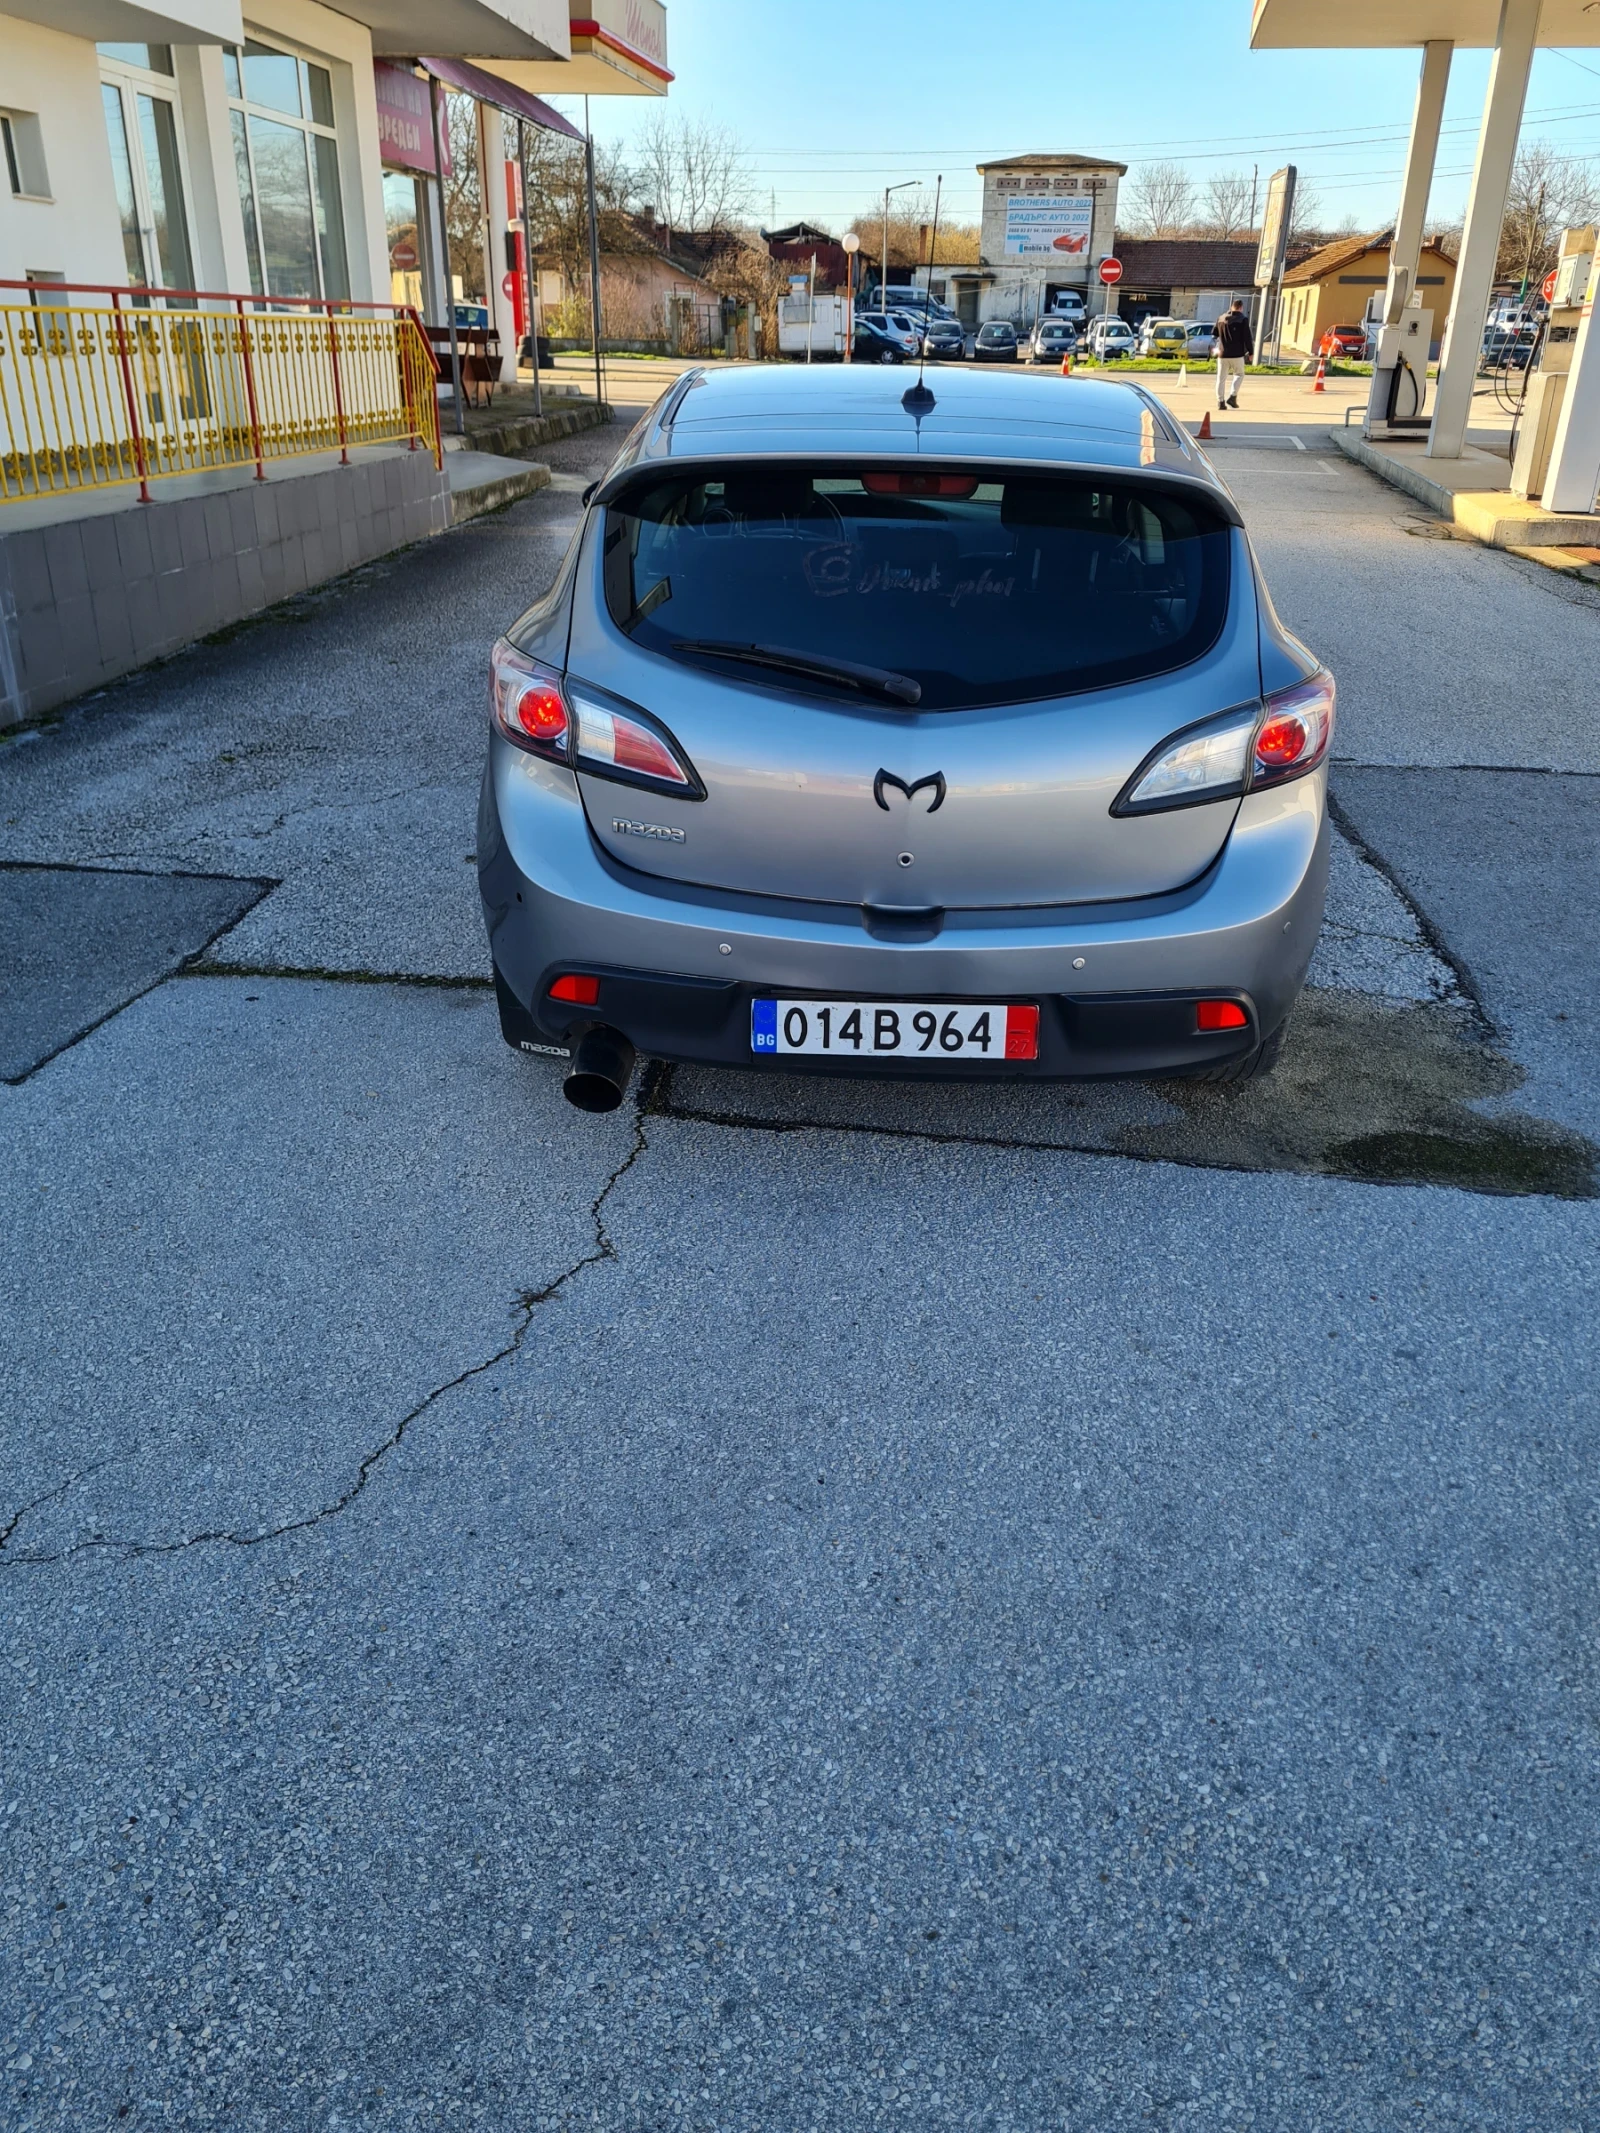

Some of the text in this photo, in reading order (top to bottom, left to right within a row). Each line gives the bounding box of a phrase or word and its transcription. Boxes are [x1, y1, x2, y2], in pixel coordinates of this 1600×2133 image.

[1008, 199, 1050, 207] BROTHERS
[1052, 199, 1073, 207] AUTO
[1008, 213, 1047, 222] БРАДЪРС
[757, 1034, 775, 1046] BG
[521, 1041, 571, 1057] mazda
